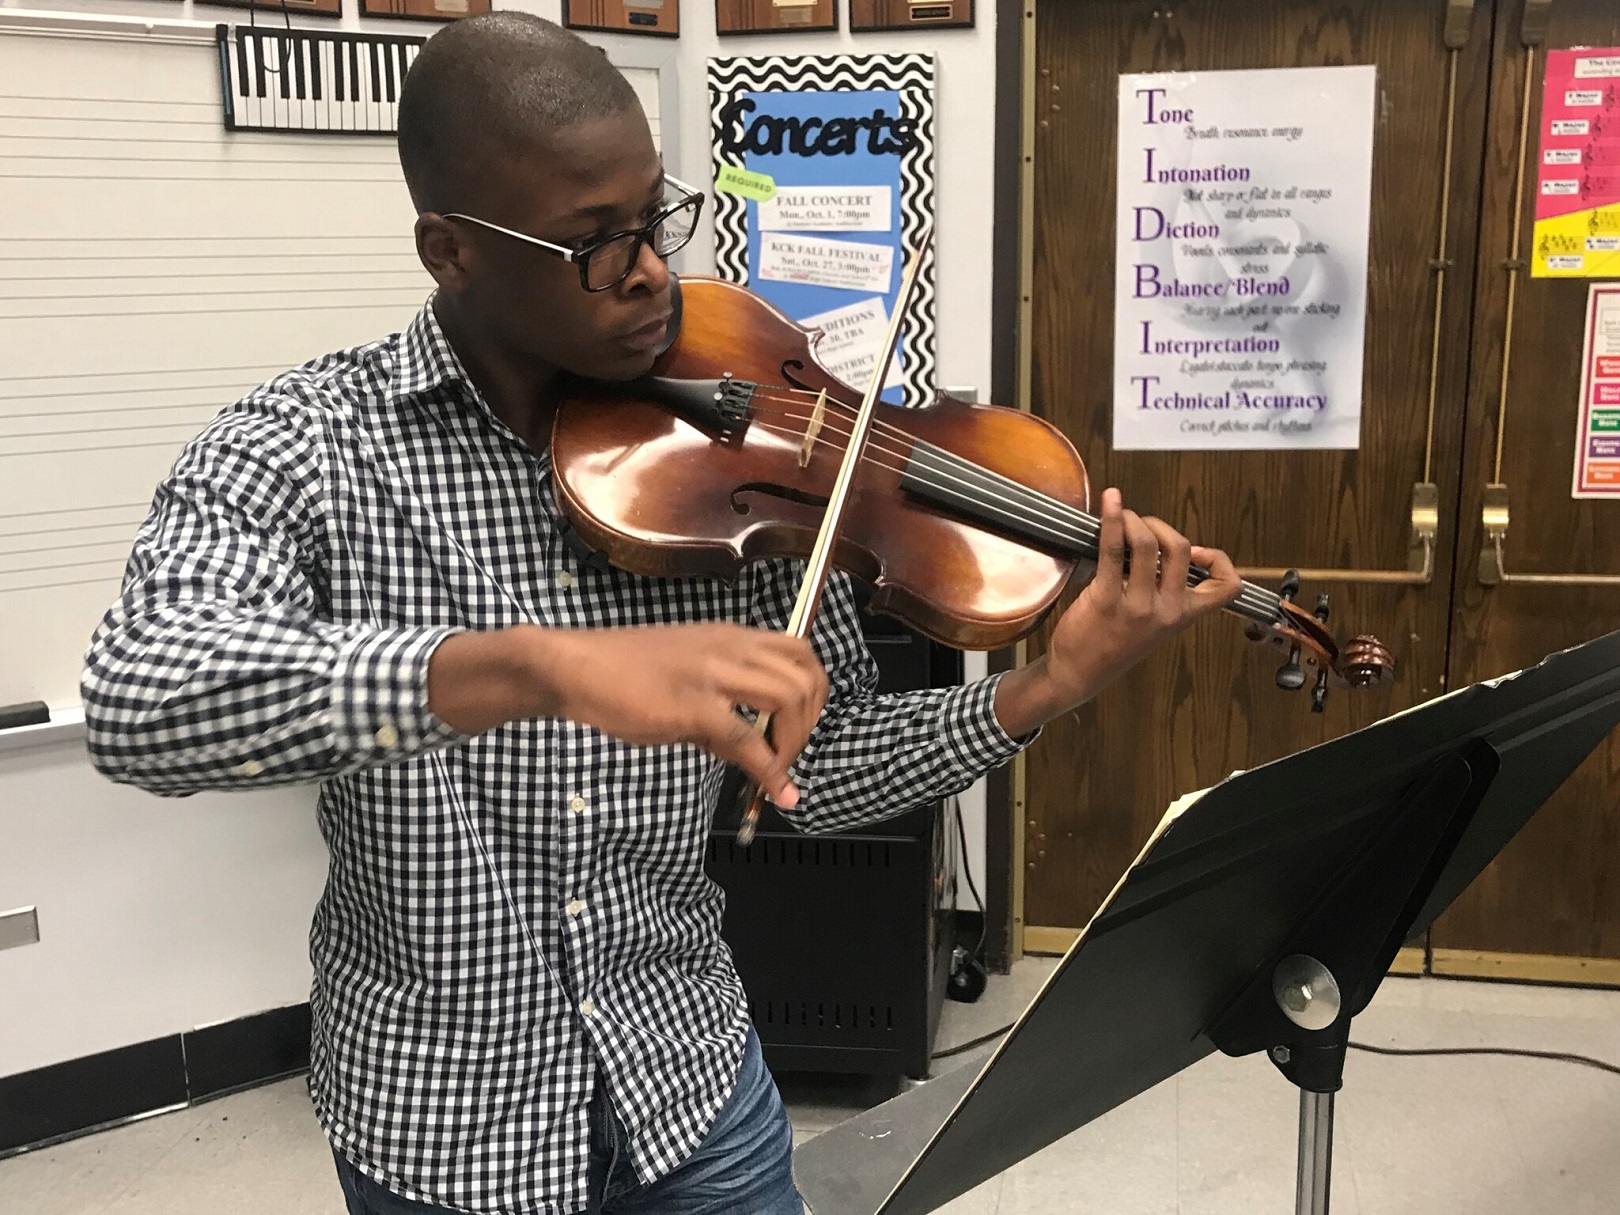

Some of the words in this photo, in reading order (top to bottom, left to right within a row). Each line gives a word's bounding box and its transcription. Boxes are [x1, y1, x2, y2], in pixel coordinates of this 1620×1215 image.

[1135, 88, 1194, 125] Tone
[721, 98, 918, 157] Concerts
[725, 174, 772, 193] REQUIRED
[1142, 148, 1251, 184] Intonation
[776, 196, 809, 207] FALL
[811, 195, 873, 207] CONCERT
[1132, 206, 1219, 241] Diction
[771, 241, 795, 254] KCK
[797, 243, 823, 257] FALL
[828, 248, 881, 263] FESTIVAL
[1139, 320, 1280, 357] Interpretation
[1130, 376, 1230, 411] Technical
[1234, 391, 1328, 413] Accuracy
